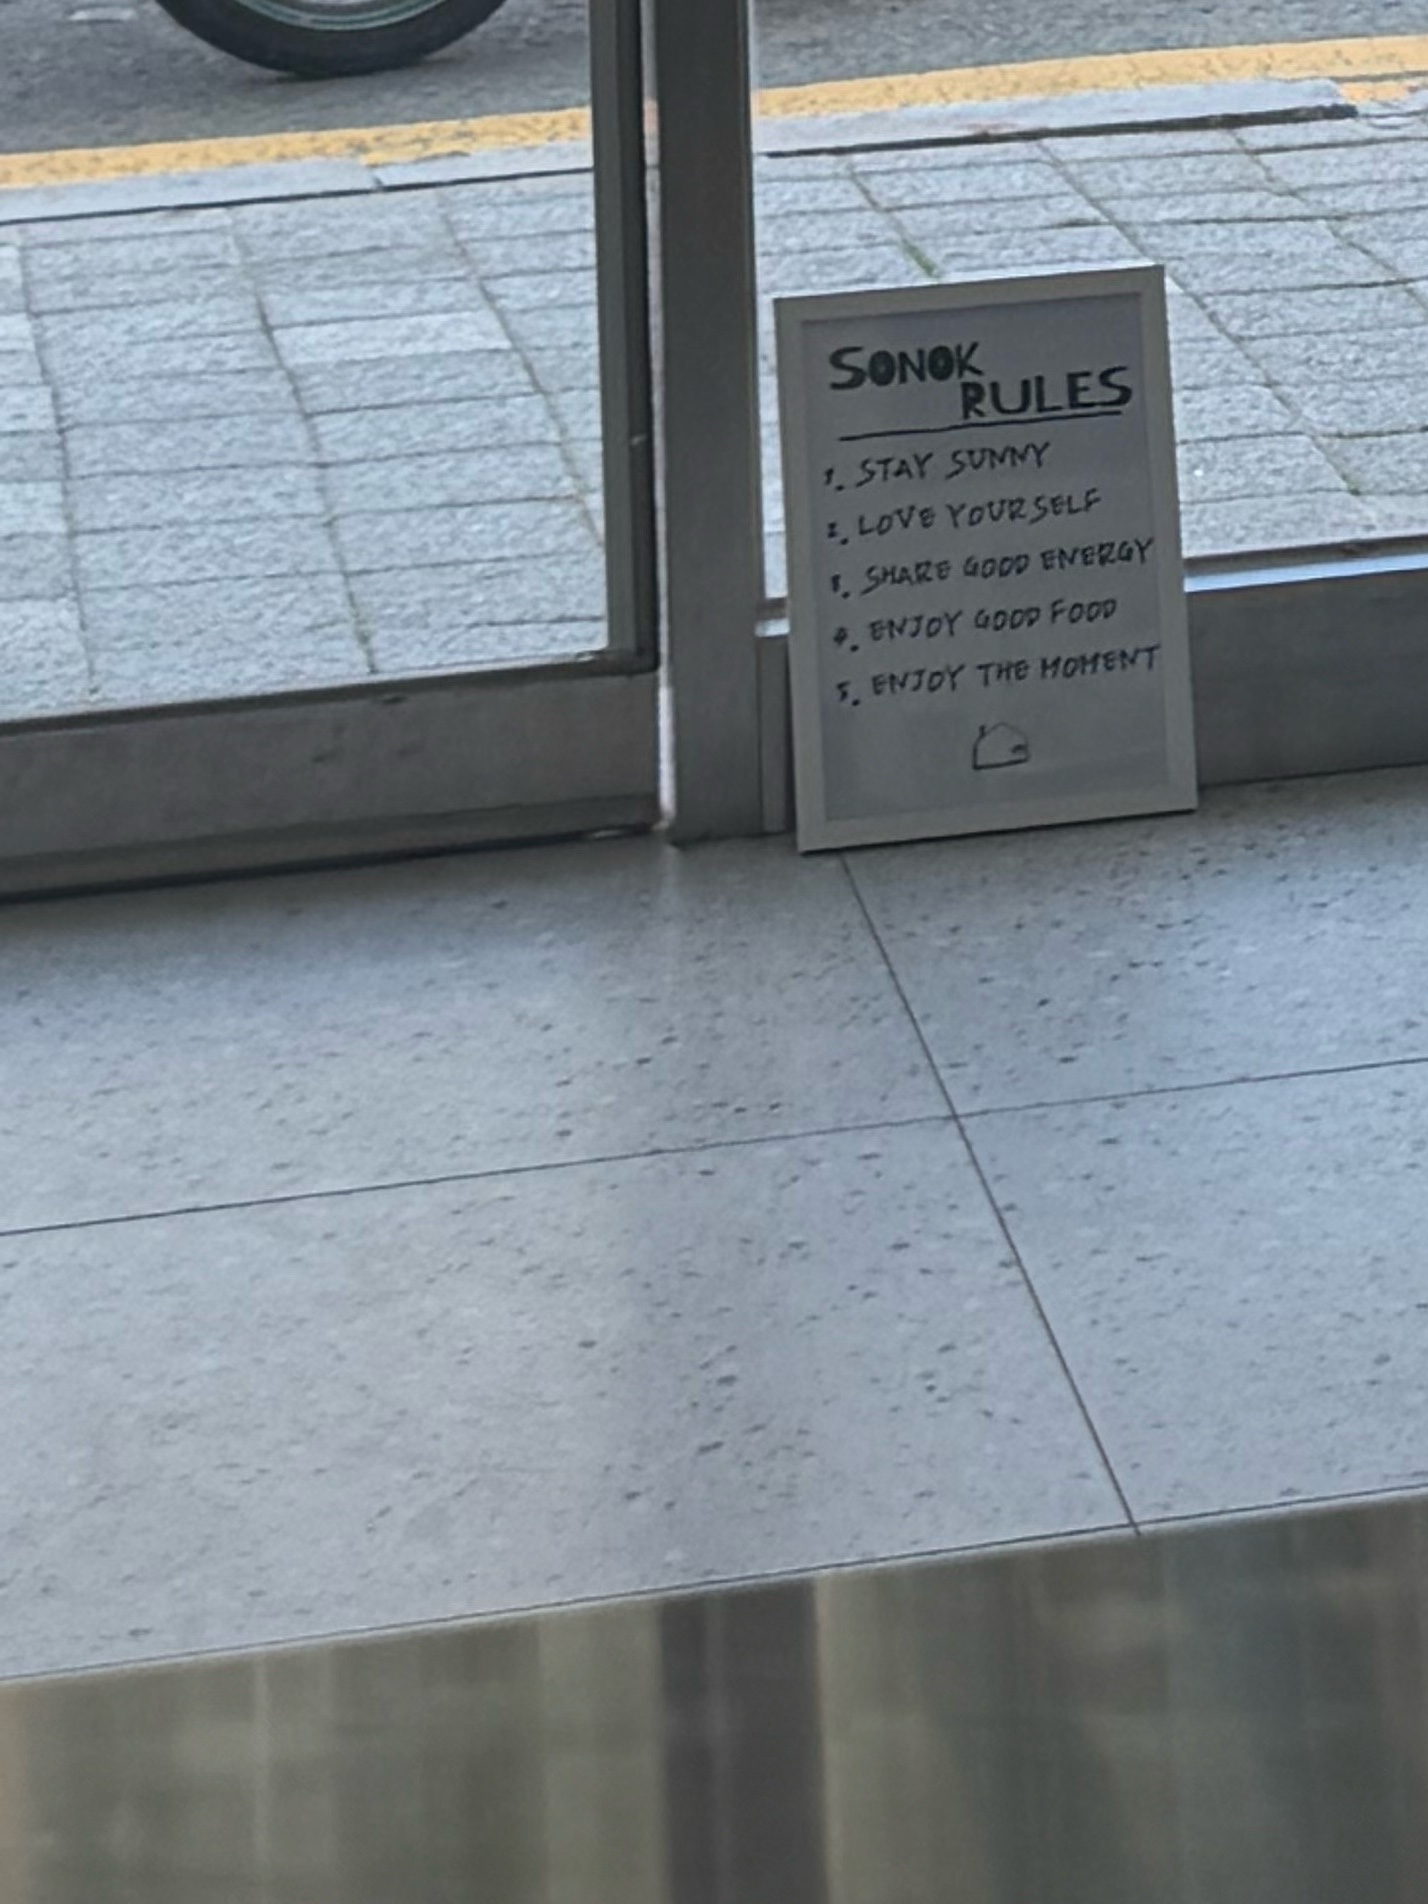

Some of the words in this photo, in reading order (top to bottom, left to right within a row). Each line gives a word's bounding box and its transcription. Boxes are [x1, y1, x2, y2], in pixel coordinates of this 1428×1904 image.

[829, 342, 984, 391] SONOK
[961, 365, 1133, 421] RULES
[855, 452, 934, 488] STAY
[945, 442, 1050, 481] SUNNY
[858, 507, 935, 537] LOVE
[945, 488, 1102, 530] YOURSELF
[860, 558, 952, 596] SHARE
[965, 553, 1030, 580] GOOD
[1041, 537, 1156, 570] ENERGY
[870, 610, 962, 641] ENJOY
[975, 606, 1039, 631] GOOD
[1050, 598, 1117, 624] FOOD
[871, 664, 966, 695] ENJOY
[977, 661, 1030, 687] THE
[1040, 644, 1162, 679] MOMENT
